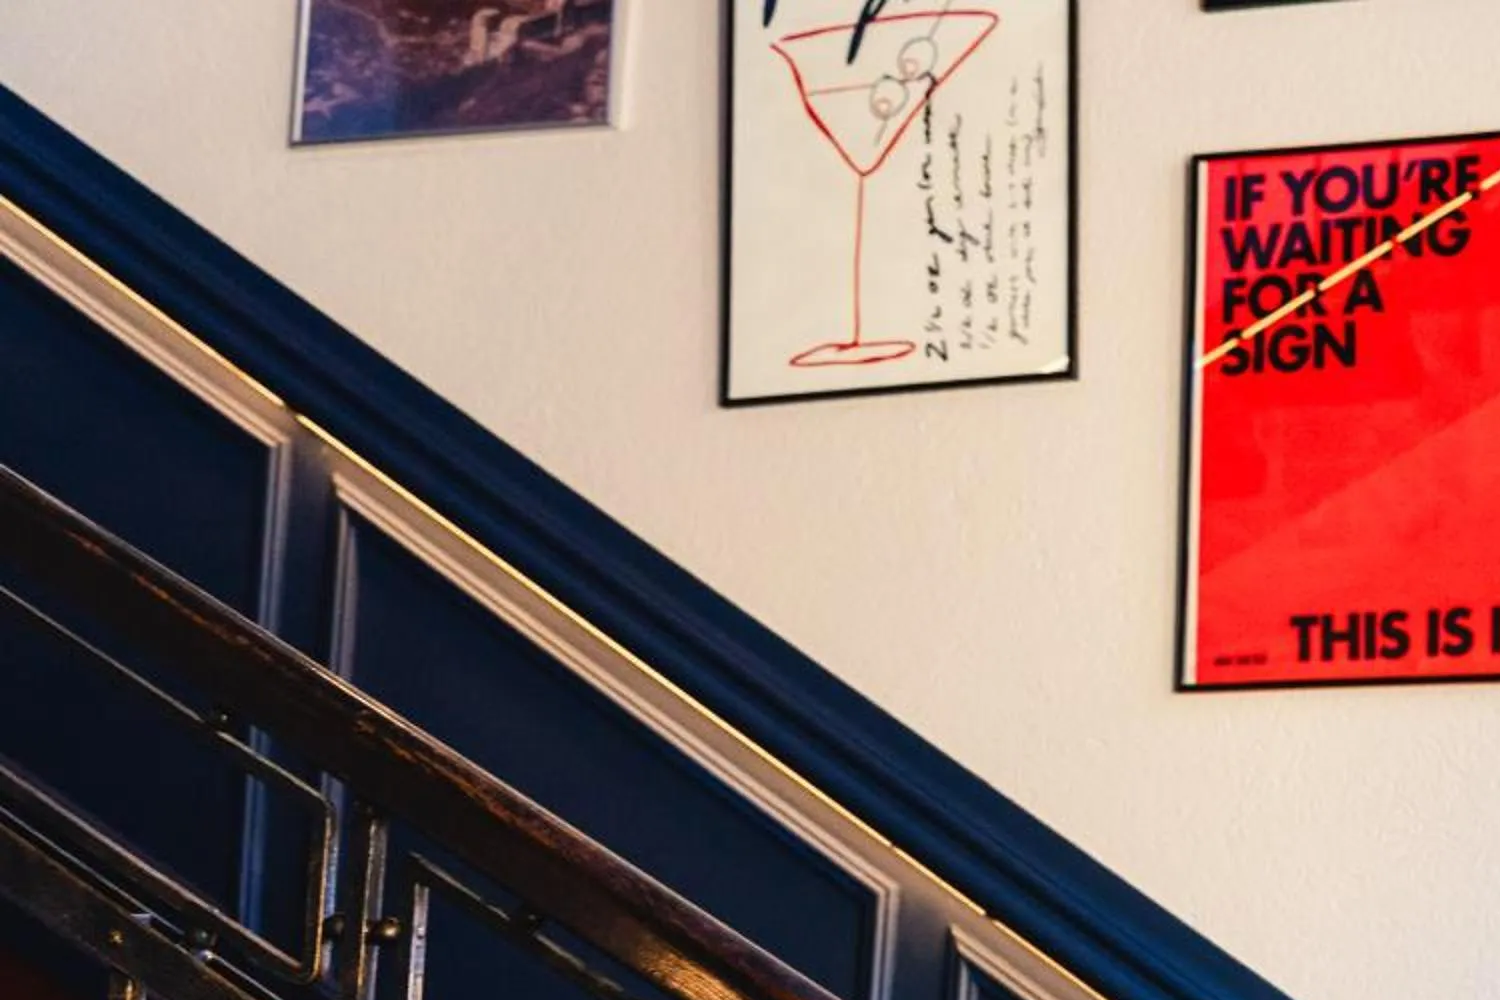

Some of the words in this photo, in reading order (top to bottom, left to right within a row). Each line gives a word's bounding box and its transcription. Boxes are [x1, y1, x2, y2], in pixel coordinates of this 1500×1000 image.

[1224, 173, 1265, 222] IF
[1278, 154, 1482, 217] YOU'RE
[1219, 210, 1473, 272] WAITING
[1221, 273, 1328, 325] FOR
[1342, 267, 1386, 315] A
[1219, 319, 1358, 377] SIGN
[1290, 611, 1411, 663] THIS
[1426, 606, 1475, 657] IS
